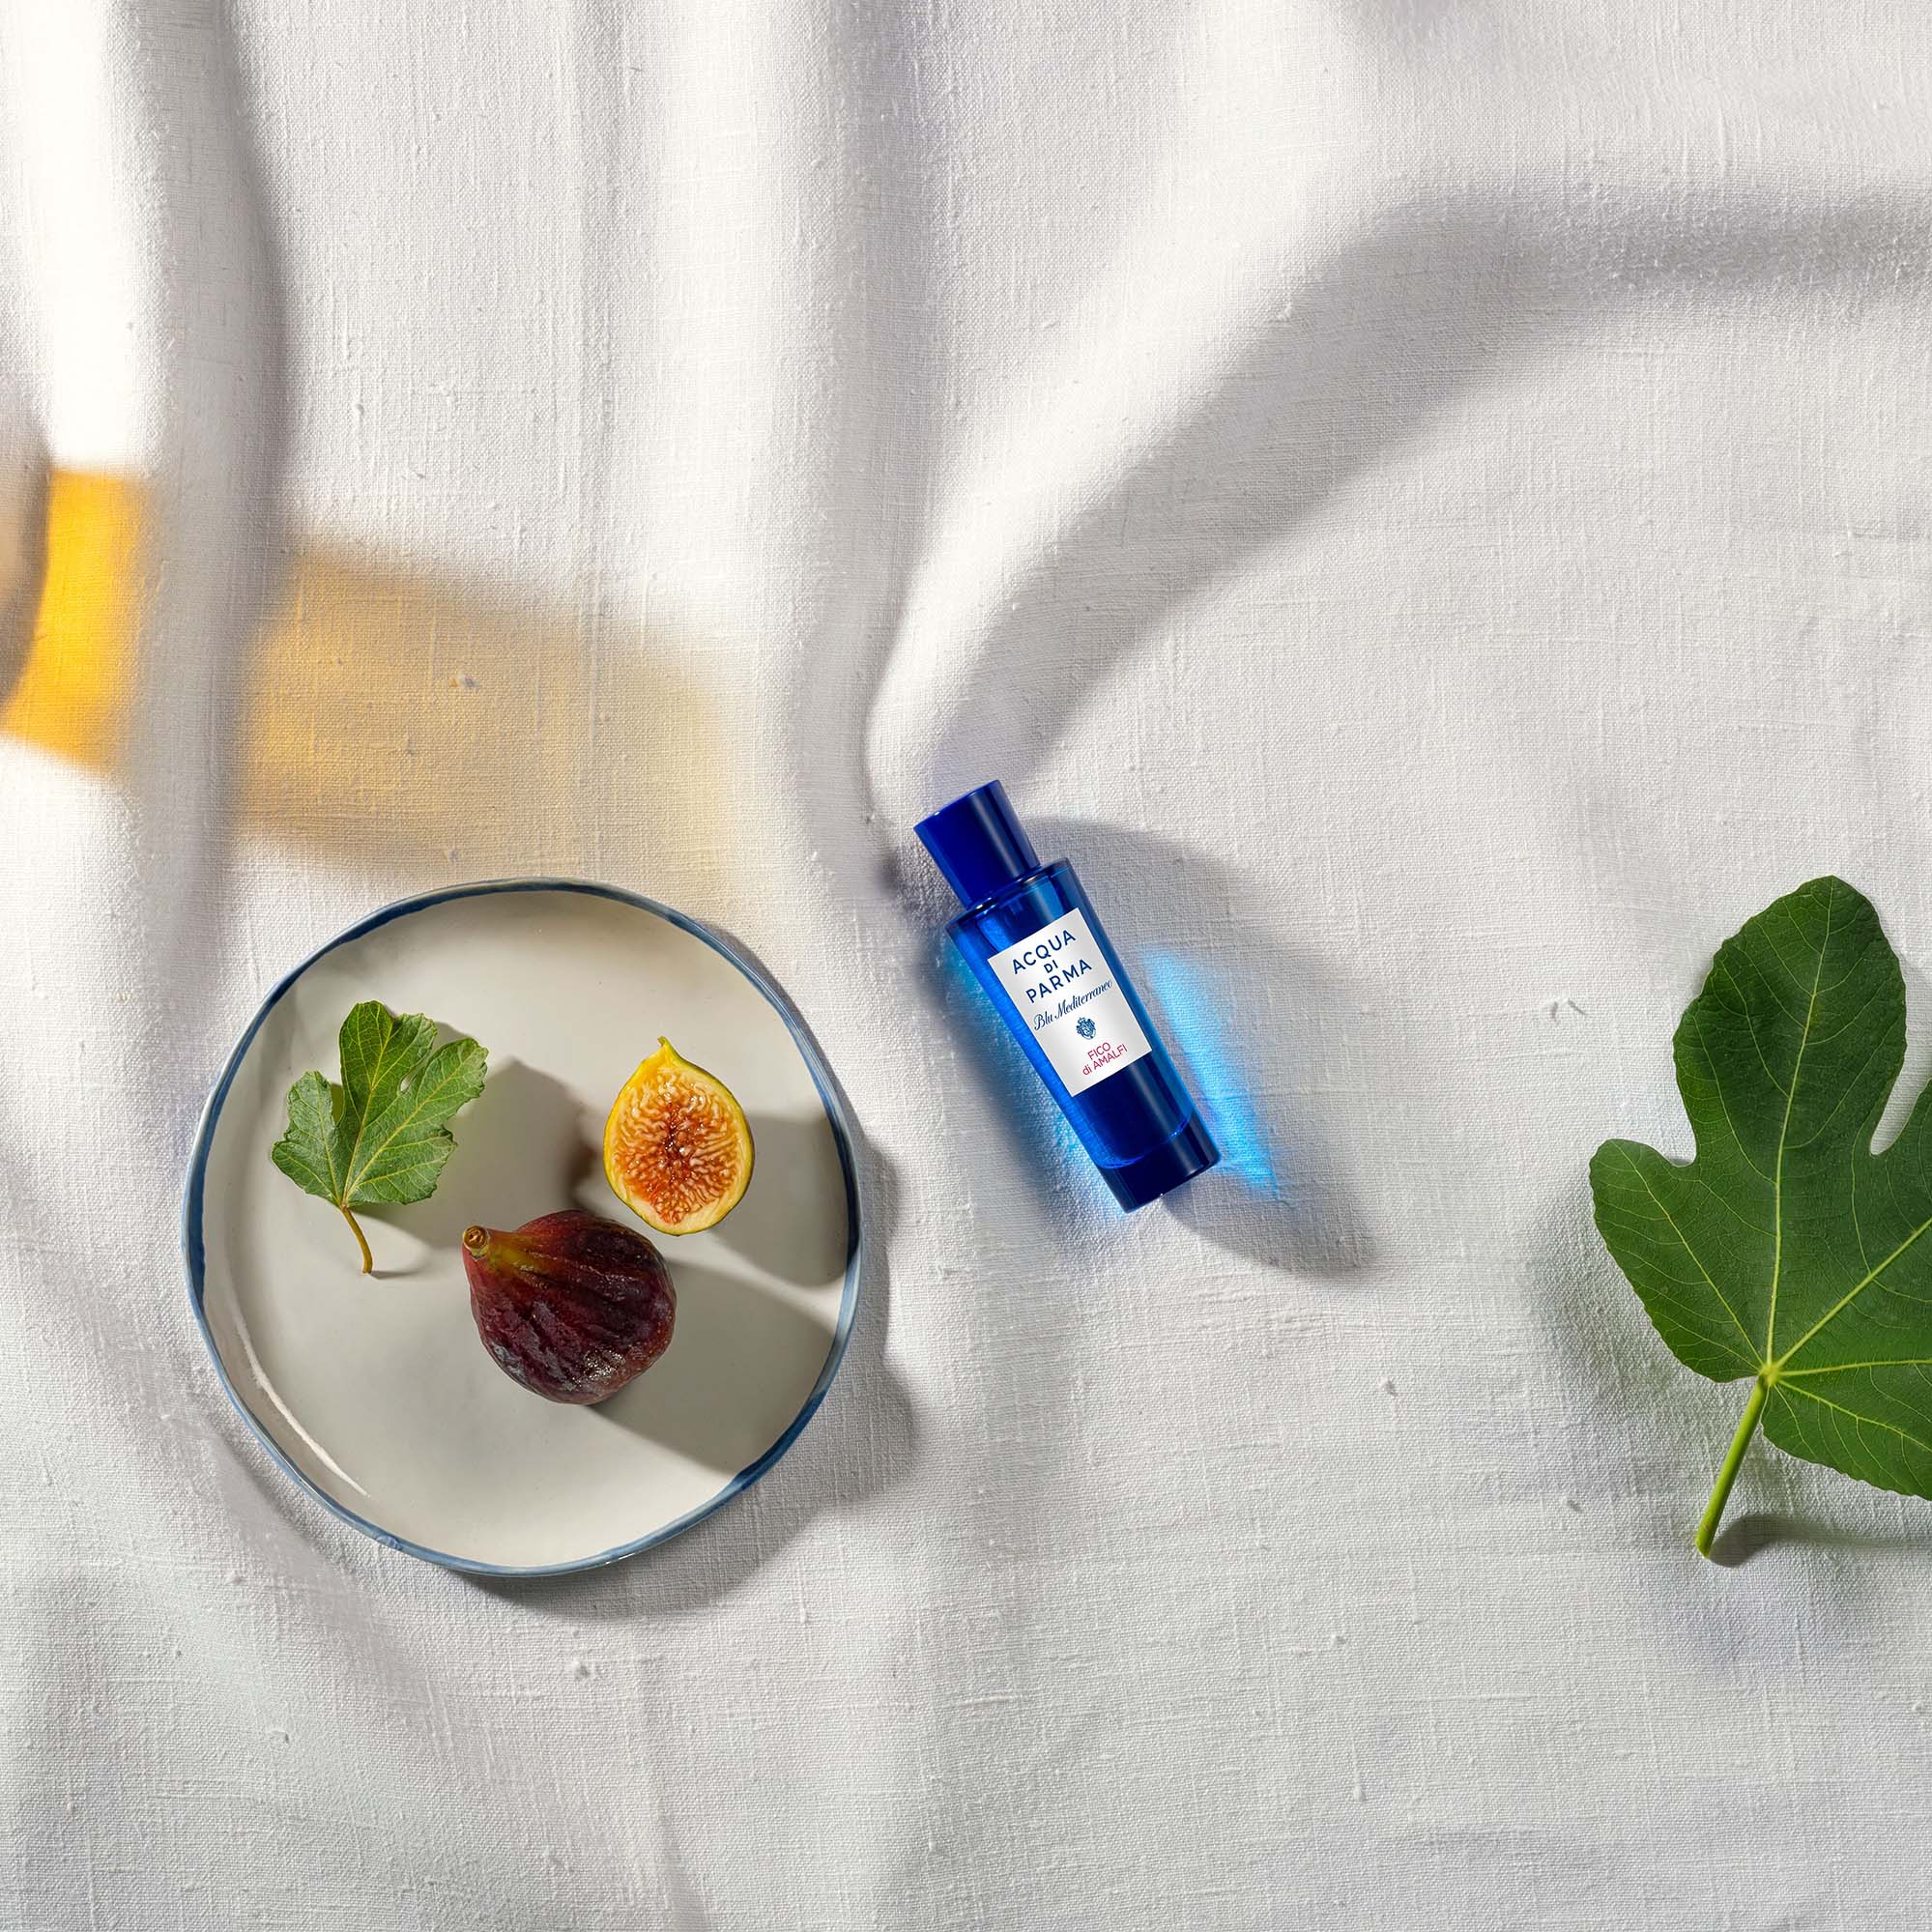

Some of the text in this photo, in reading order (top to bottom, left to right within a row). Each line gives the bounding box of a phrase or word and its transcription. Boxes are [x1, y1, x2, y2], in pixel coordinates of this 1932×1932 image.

[1012, 929, 1077, 975] ACQUA
[1043, 959, 1059, 974] DI
[1025, 959, 1092, 1004] PARMA
[1033, 979, 1112, 1030] Blu Mediterraneo
[1082, 1044, 1128, 1076] di AMALFI
[1087, 1042, 1111, 1061] FICO
